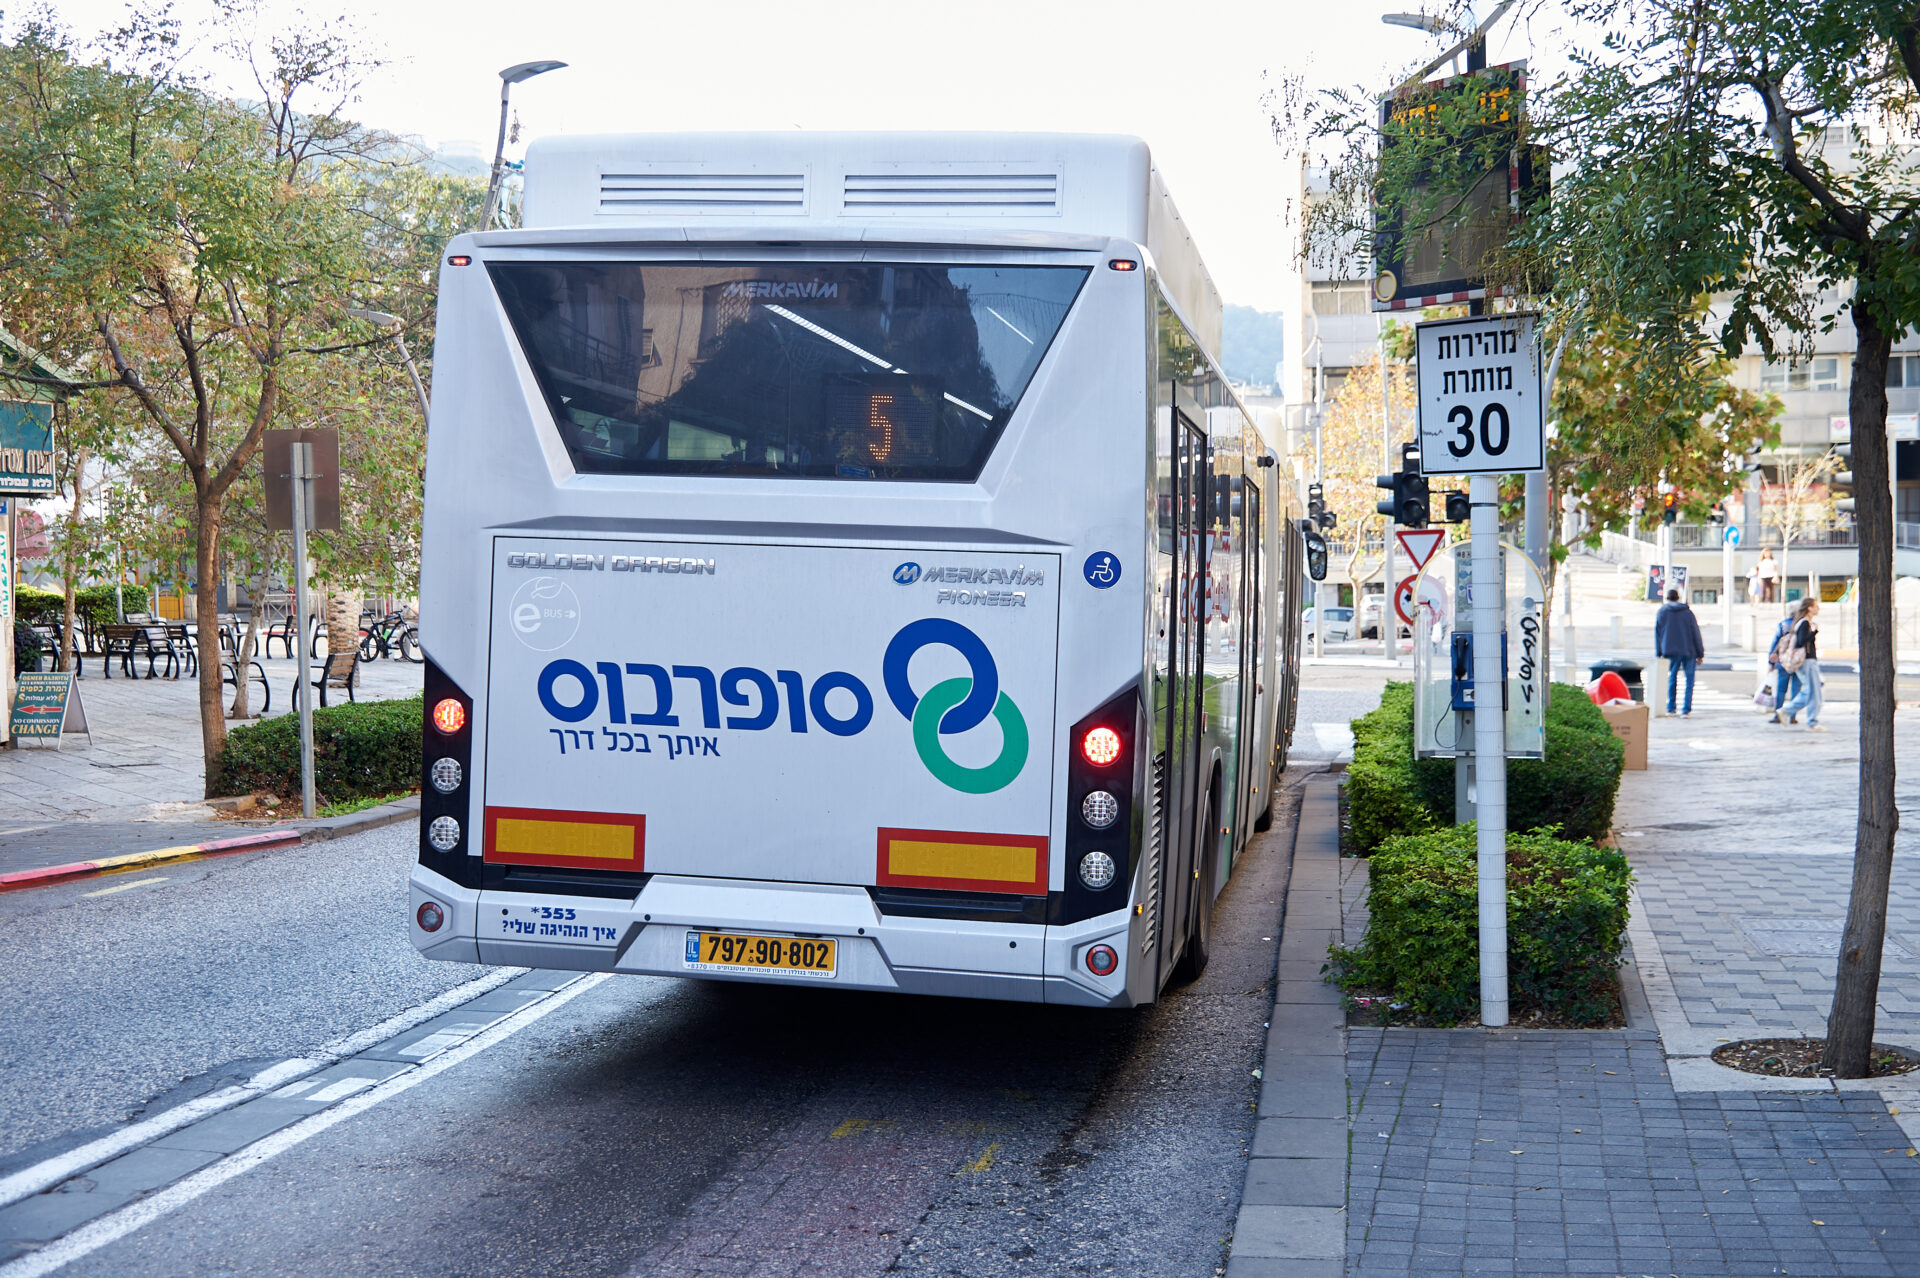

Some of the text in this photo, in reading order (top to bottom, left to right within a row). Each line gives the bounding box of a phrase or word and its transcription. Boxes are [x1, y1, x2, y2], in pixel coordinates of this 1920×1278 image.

[1438, 329, 1517, 360] מהירות
[1443, 366, 1512, 395] מותרת
[869, 395, 893, 460] 5
[1447, 402, 1510, 458] 30
[507, 551, 715, 575] GOLDEN DRAGON
[937, 588, 1027, 607] PIONEER
[543, 608, 562, 619] BUS
[537, 658, 874, 737] סופרבוס
[11, 724, 59, 734] CHANGE
[549, 726, 721, 760] איתך בכל דרך
[502, 919, 617, 941] איך הנהיגה שלי?
[687, 941, 697, 954] IL
